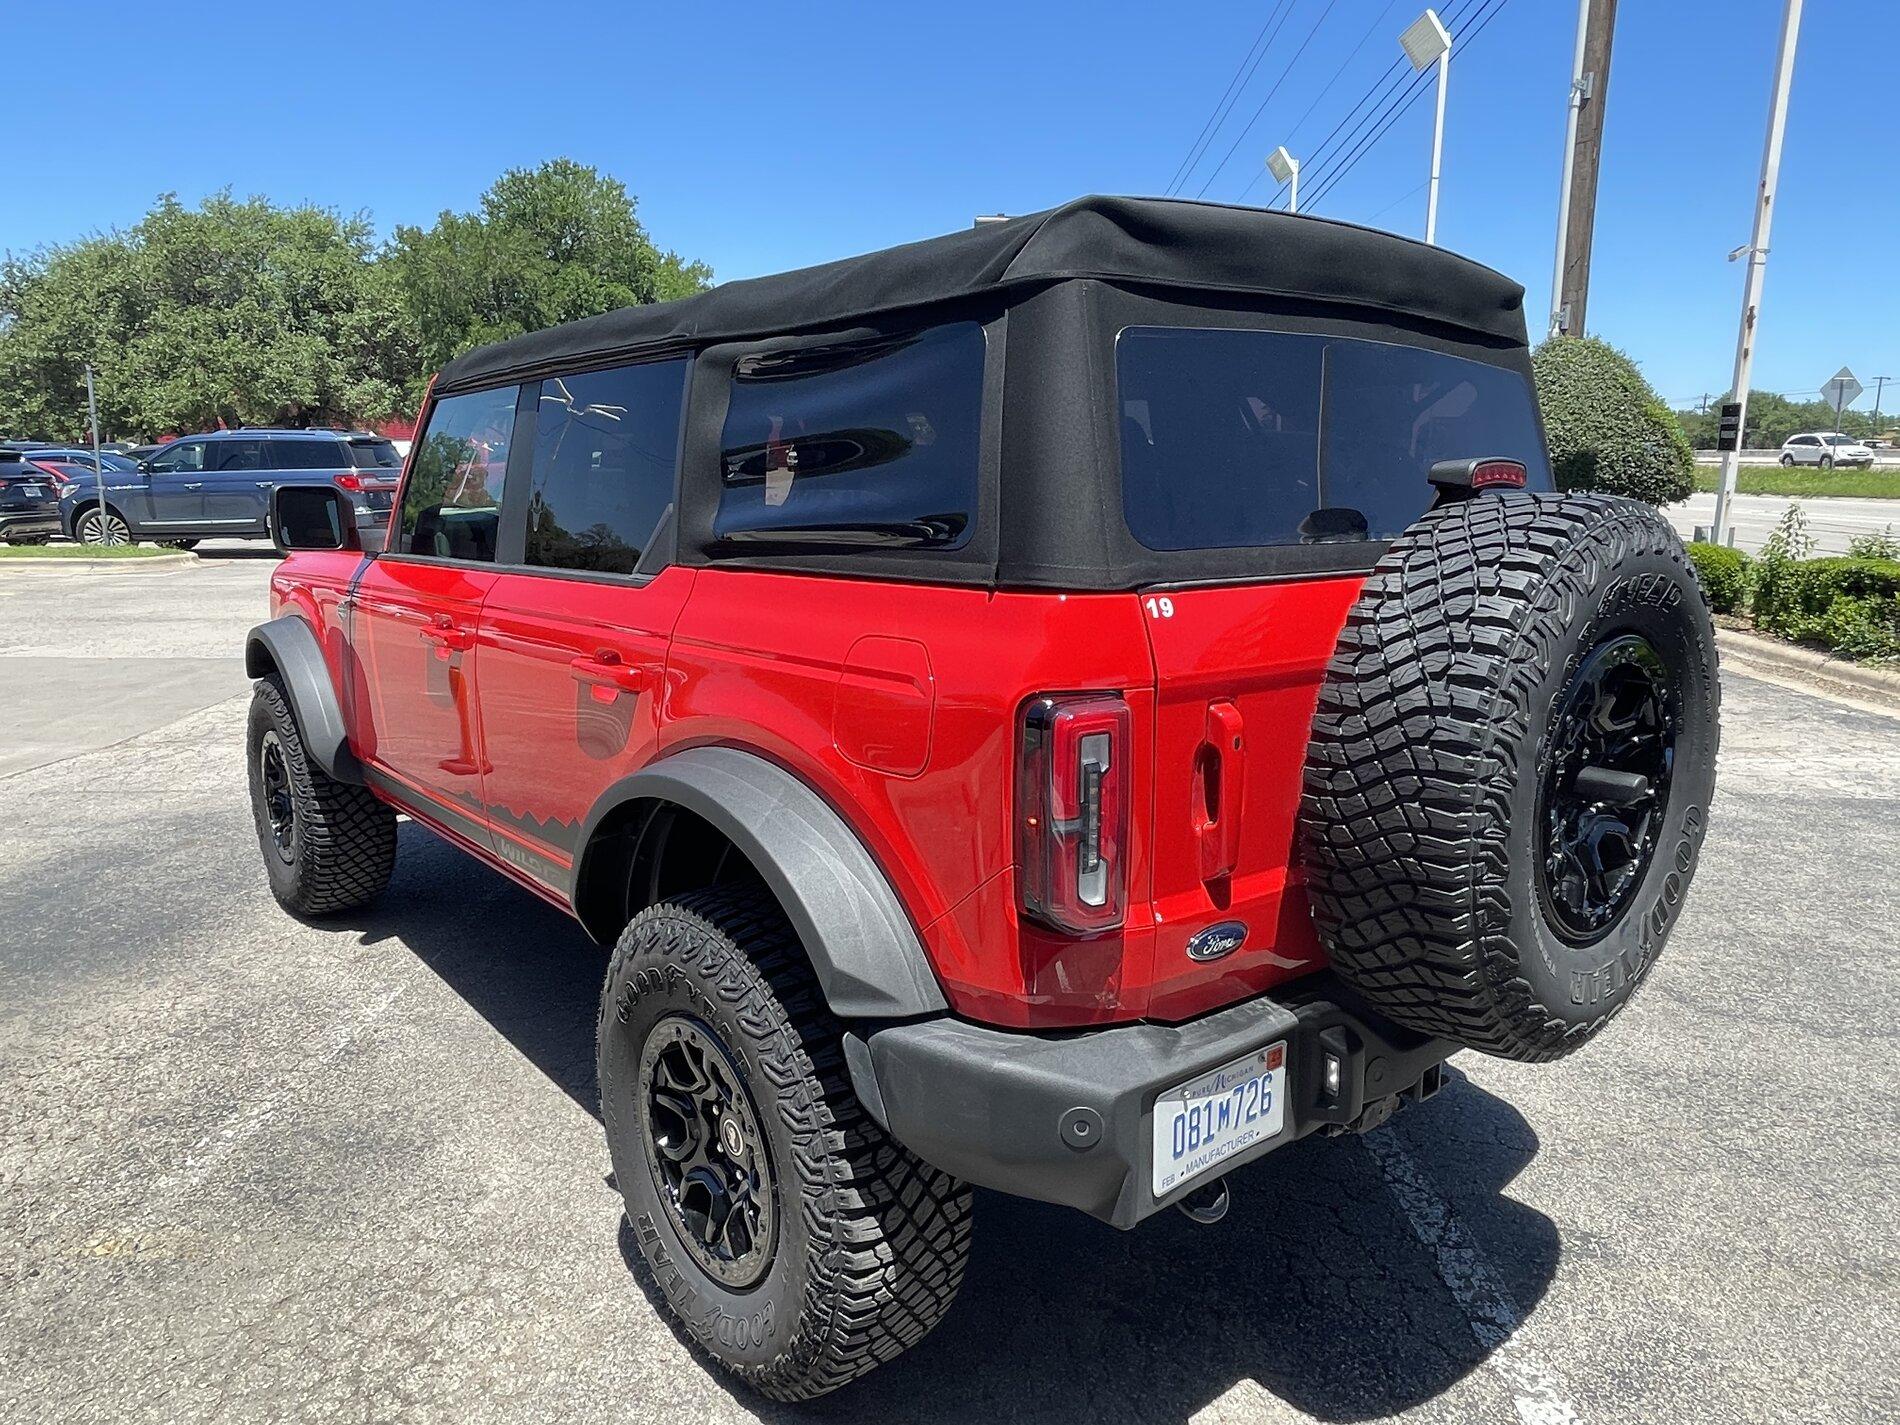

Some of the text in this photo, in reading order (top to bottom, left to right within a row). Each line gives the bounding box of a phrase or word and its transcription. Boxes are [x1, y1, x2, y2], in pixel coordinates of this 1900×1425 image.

[1145, 597, 1175, 619] 19
[1172, 1071, 1273, 1160] 081M726
[1161, 1129, 1255, 1189] FEB MANUFACTURER
